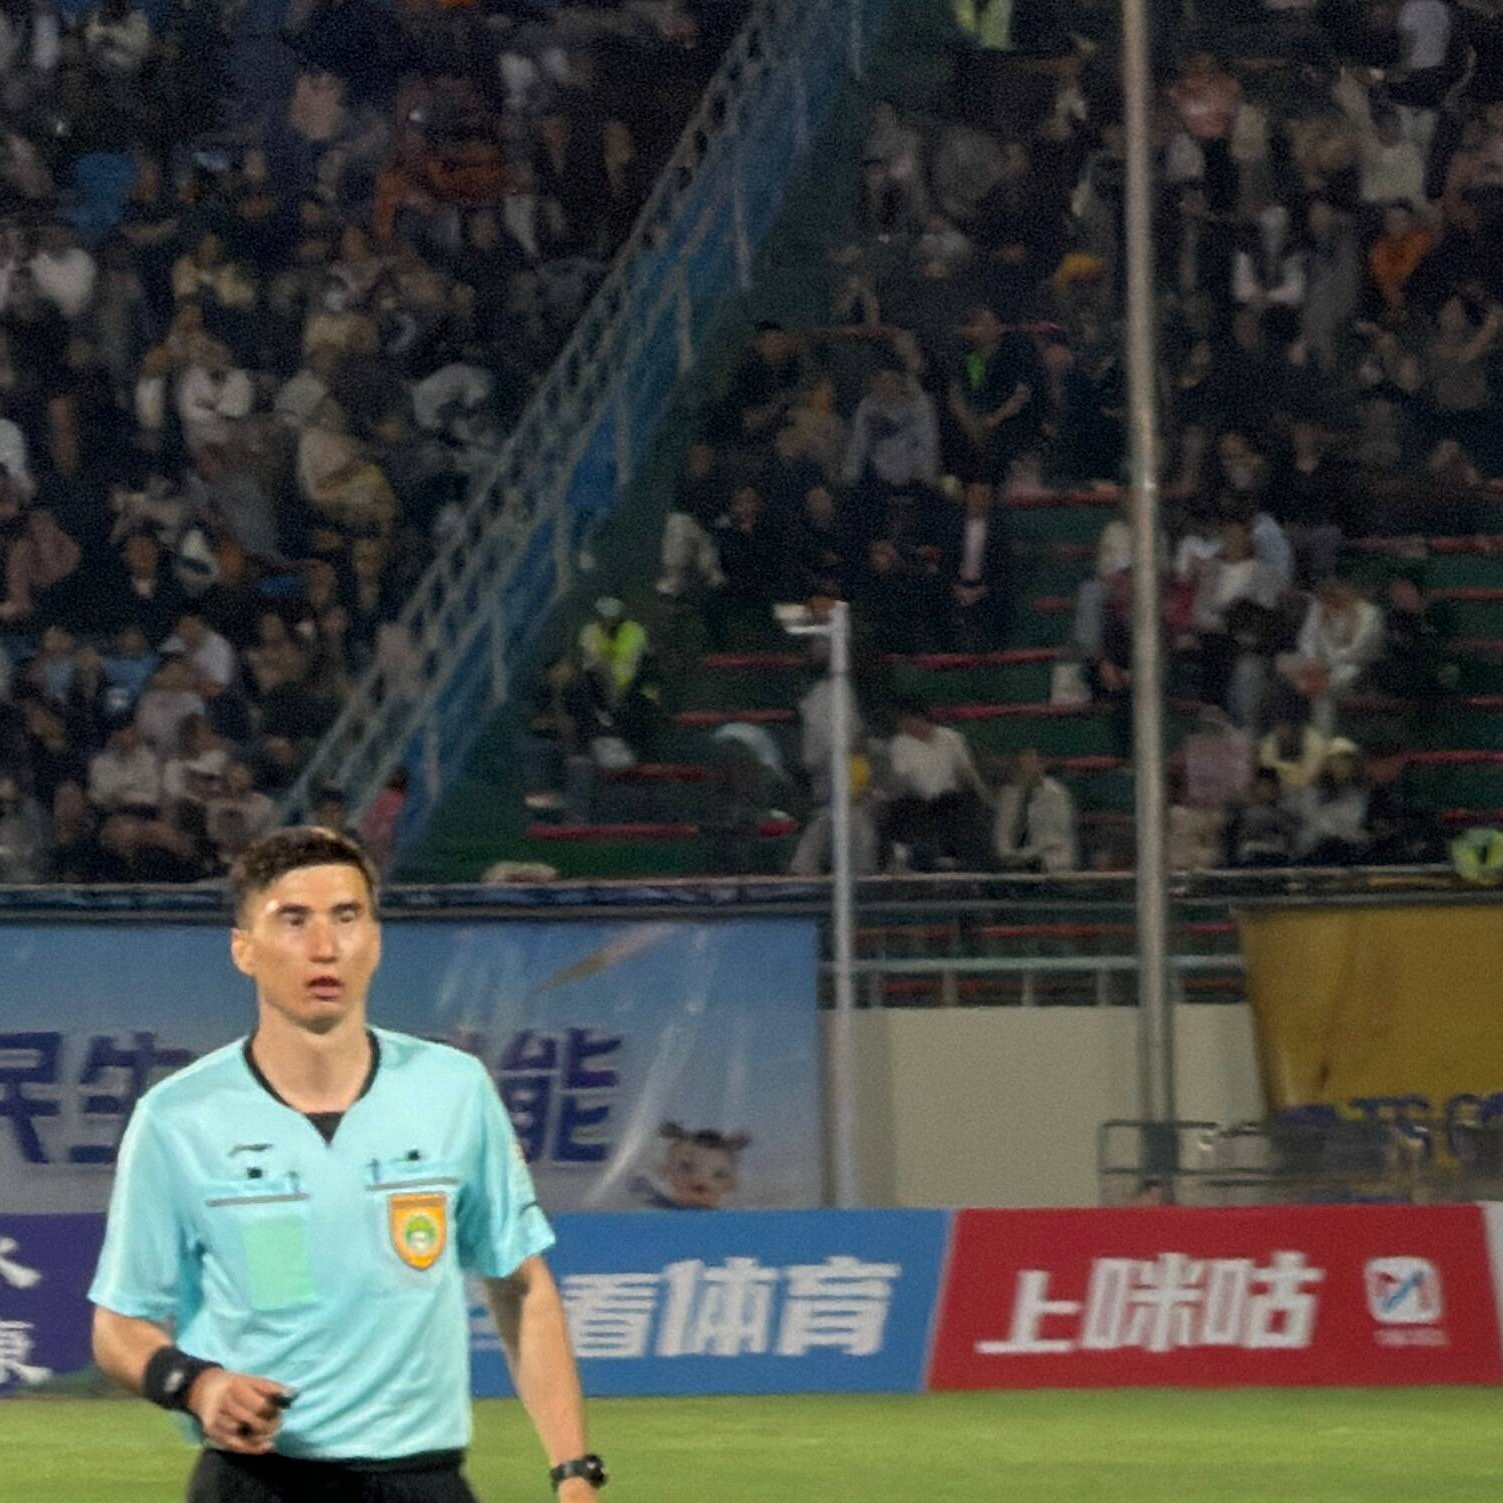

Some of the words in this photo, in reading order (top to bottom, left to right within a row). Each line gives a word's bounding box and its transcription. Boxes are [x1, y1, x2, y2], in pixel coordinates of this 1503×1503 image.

[468, 1256, 900, 1358] 看体育
[975, 1250, 1324, 1355] 上咪咕
